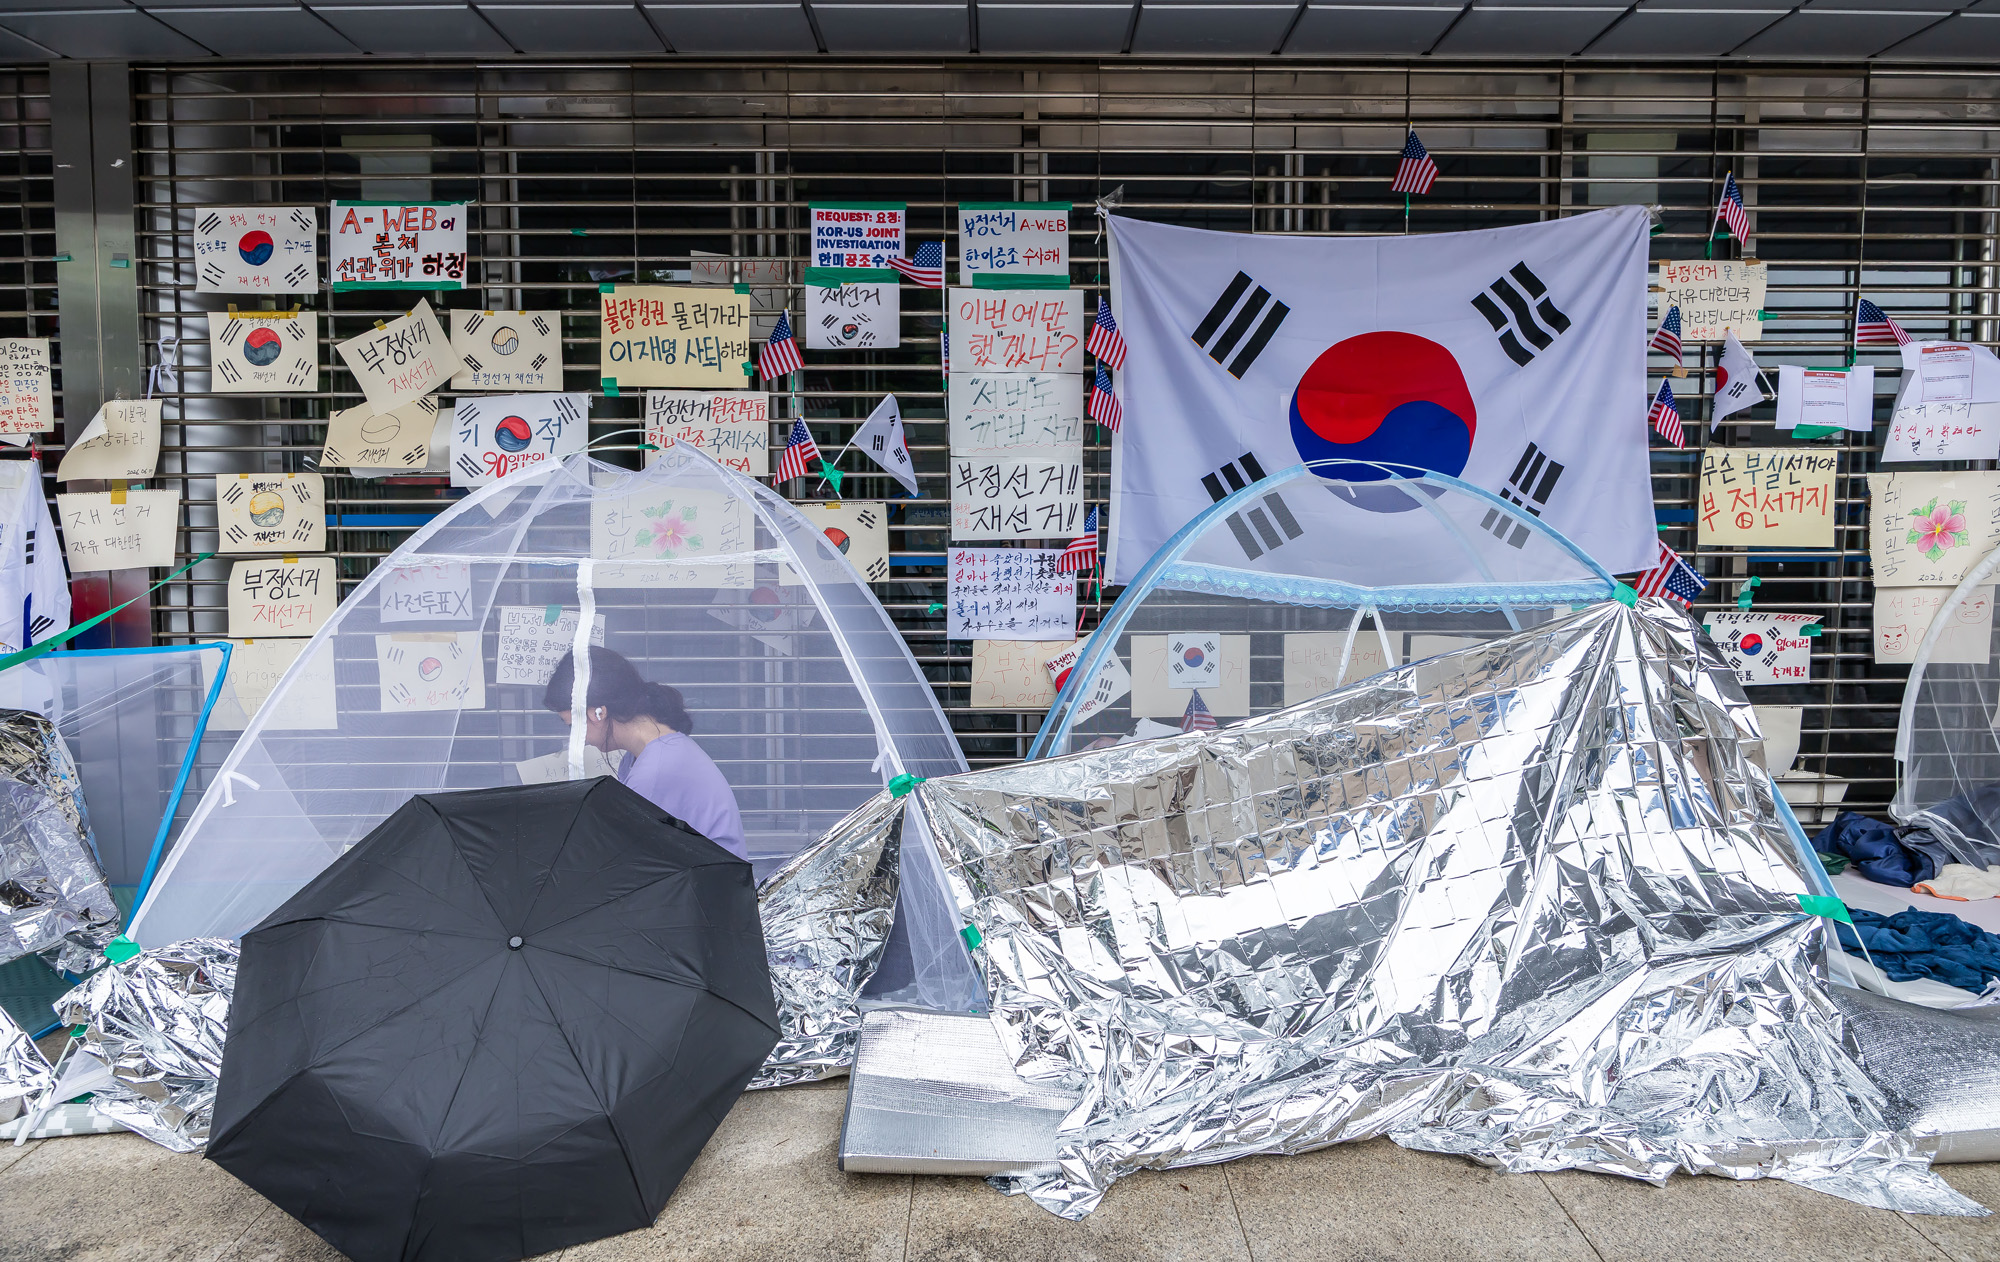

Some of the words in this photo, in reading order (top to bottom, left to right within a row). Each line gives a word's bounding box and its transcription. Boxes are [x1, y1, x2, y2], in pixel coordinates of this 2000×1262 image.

[816, 211, 873, 223] REQUEST:
[876, 211, 901, 224] 요청:
[964, 211, 1016, 238] 부정선거
[1019, 217, 1067, 233] A-WEB
[817, 226, 864, 238] KOR-US
[865, 227, 900, 238] JOINT
[336, 256, 414, 282] 선관위가
[421, 251, 467, 279] 하청
[818, 252, 898, 268] 한미공조수
[965, 247, 1020, 270] 한미공조
[1022, 247, 1060, 267] 수사해
[1666, 264, 1718, 283] 부정선거
[819, 285, 881, 308] 재선거
[1699, 286, 1750, 303] 대한민국
[603, 297, 669, 334] 불량정권
[671, 301, 749, 331] 물러가라
[960, 298, 1068, 333] 이번에만
[357, 317, 432, 375] 부정선거
[609, 335, 677, 365] 이재명
[14, 379, 40, 393] 민주당
[387, 356, 438, 394] 재선거
[1702, 453, 1737, 487] 무슨
[243, 568, 321, 600] 부정선거
[252, 603, 313, 629] 재선거
[502, 665, 534, 680] STOP
